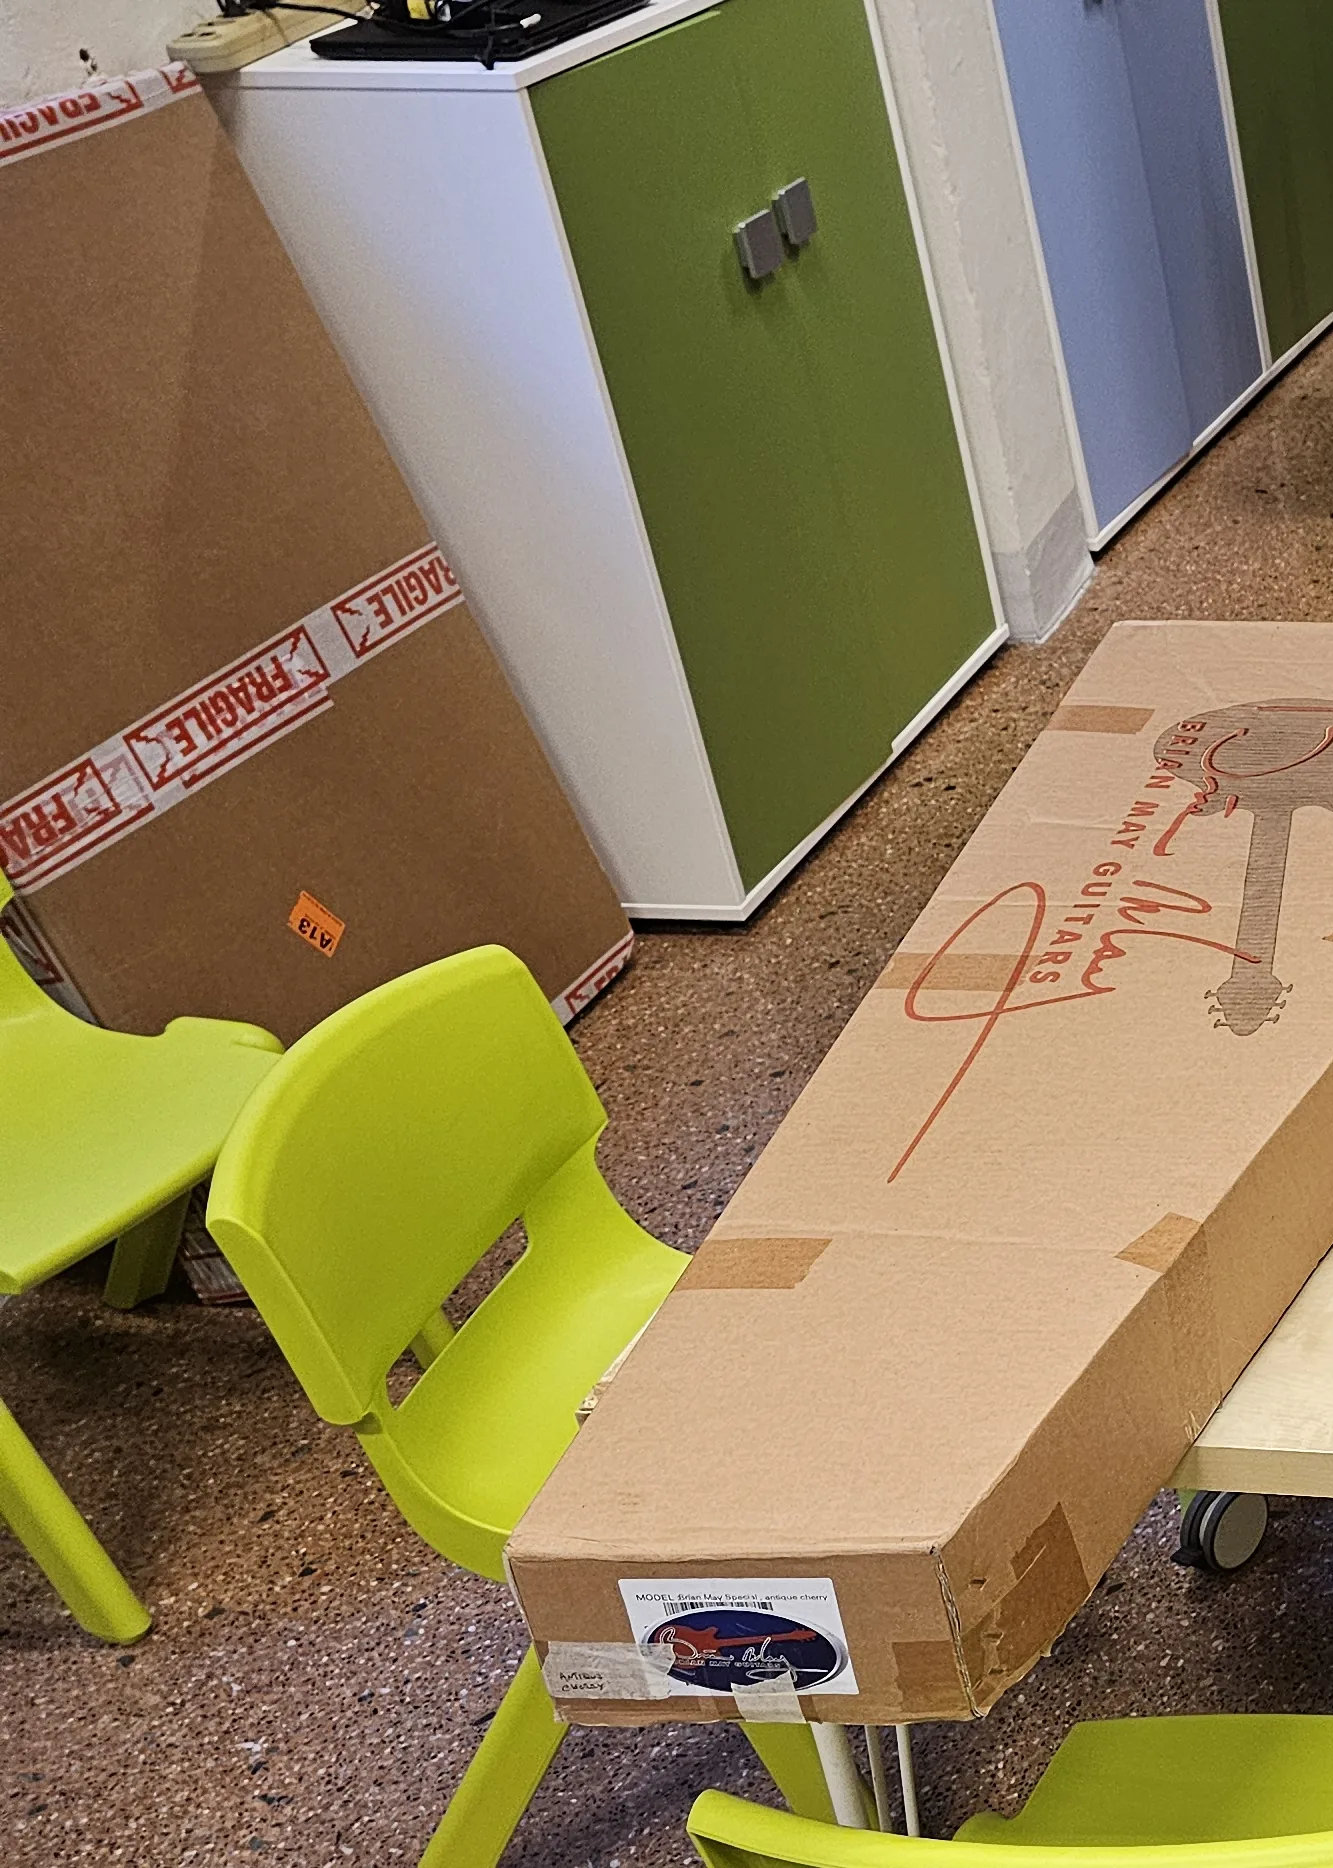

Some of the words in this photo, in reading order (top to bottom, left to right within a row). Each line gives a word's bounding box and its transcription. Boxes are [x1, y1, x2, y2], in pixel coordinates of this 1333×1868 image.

[366, 556, 457, 630] RAGILE
[165, 655, 294, 757] FRAGILE
[1144, 720, 1207, 790] BRIAN
[1111, 800, 1159, 850] MAY
[298, 918, 332, 949] A13
[1029, 861, 1123, 985] GUITARS
[636, 1593, 674, 1601] MODEL
[799, 1594, 828, 1602] cherry
